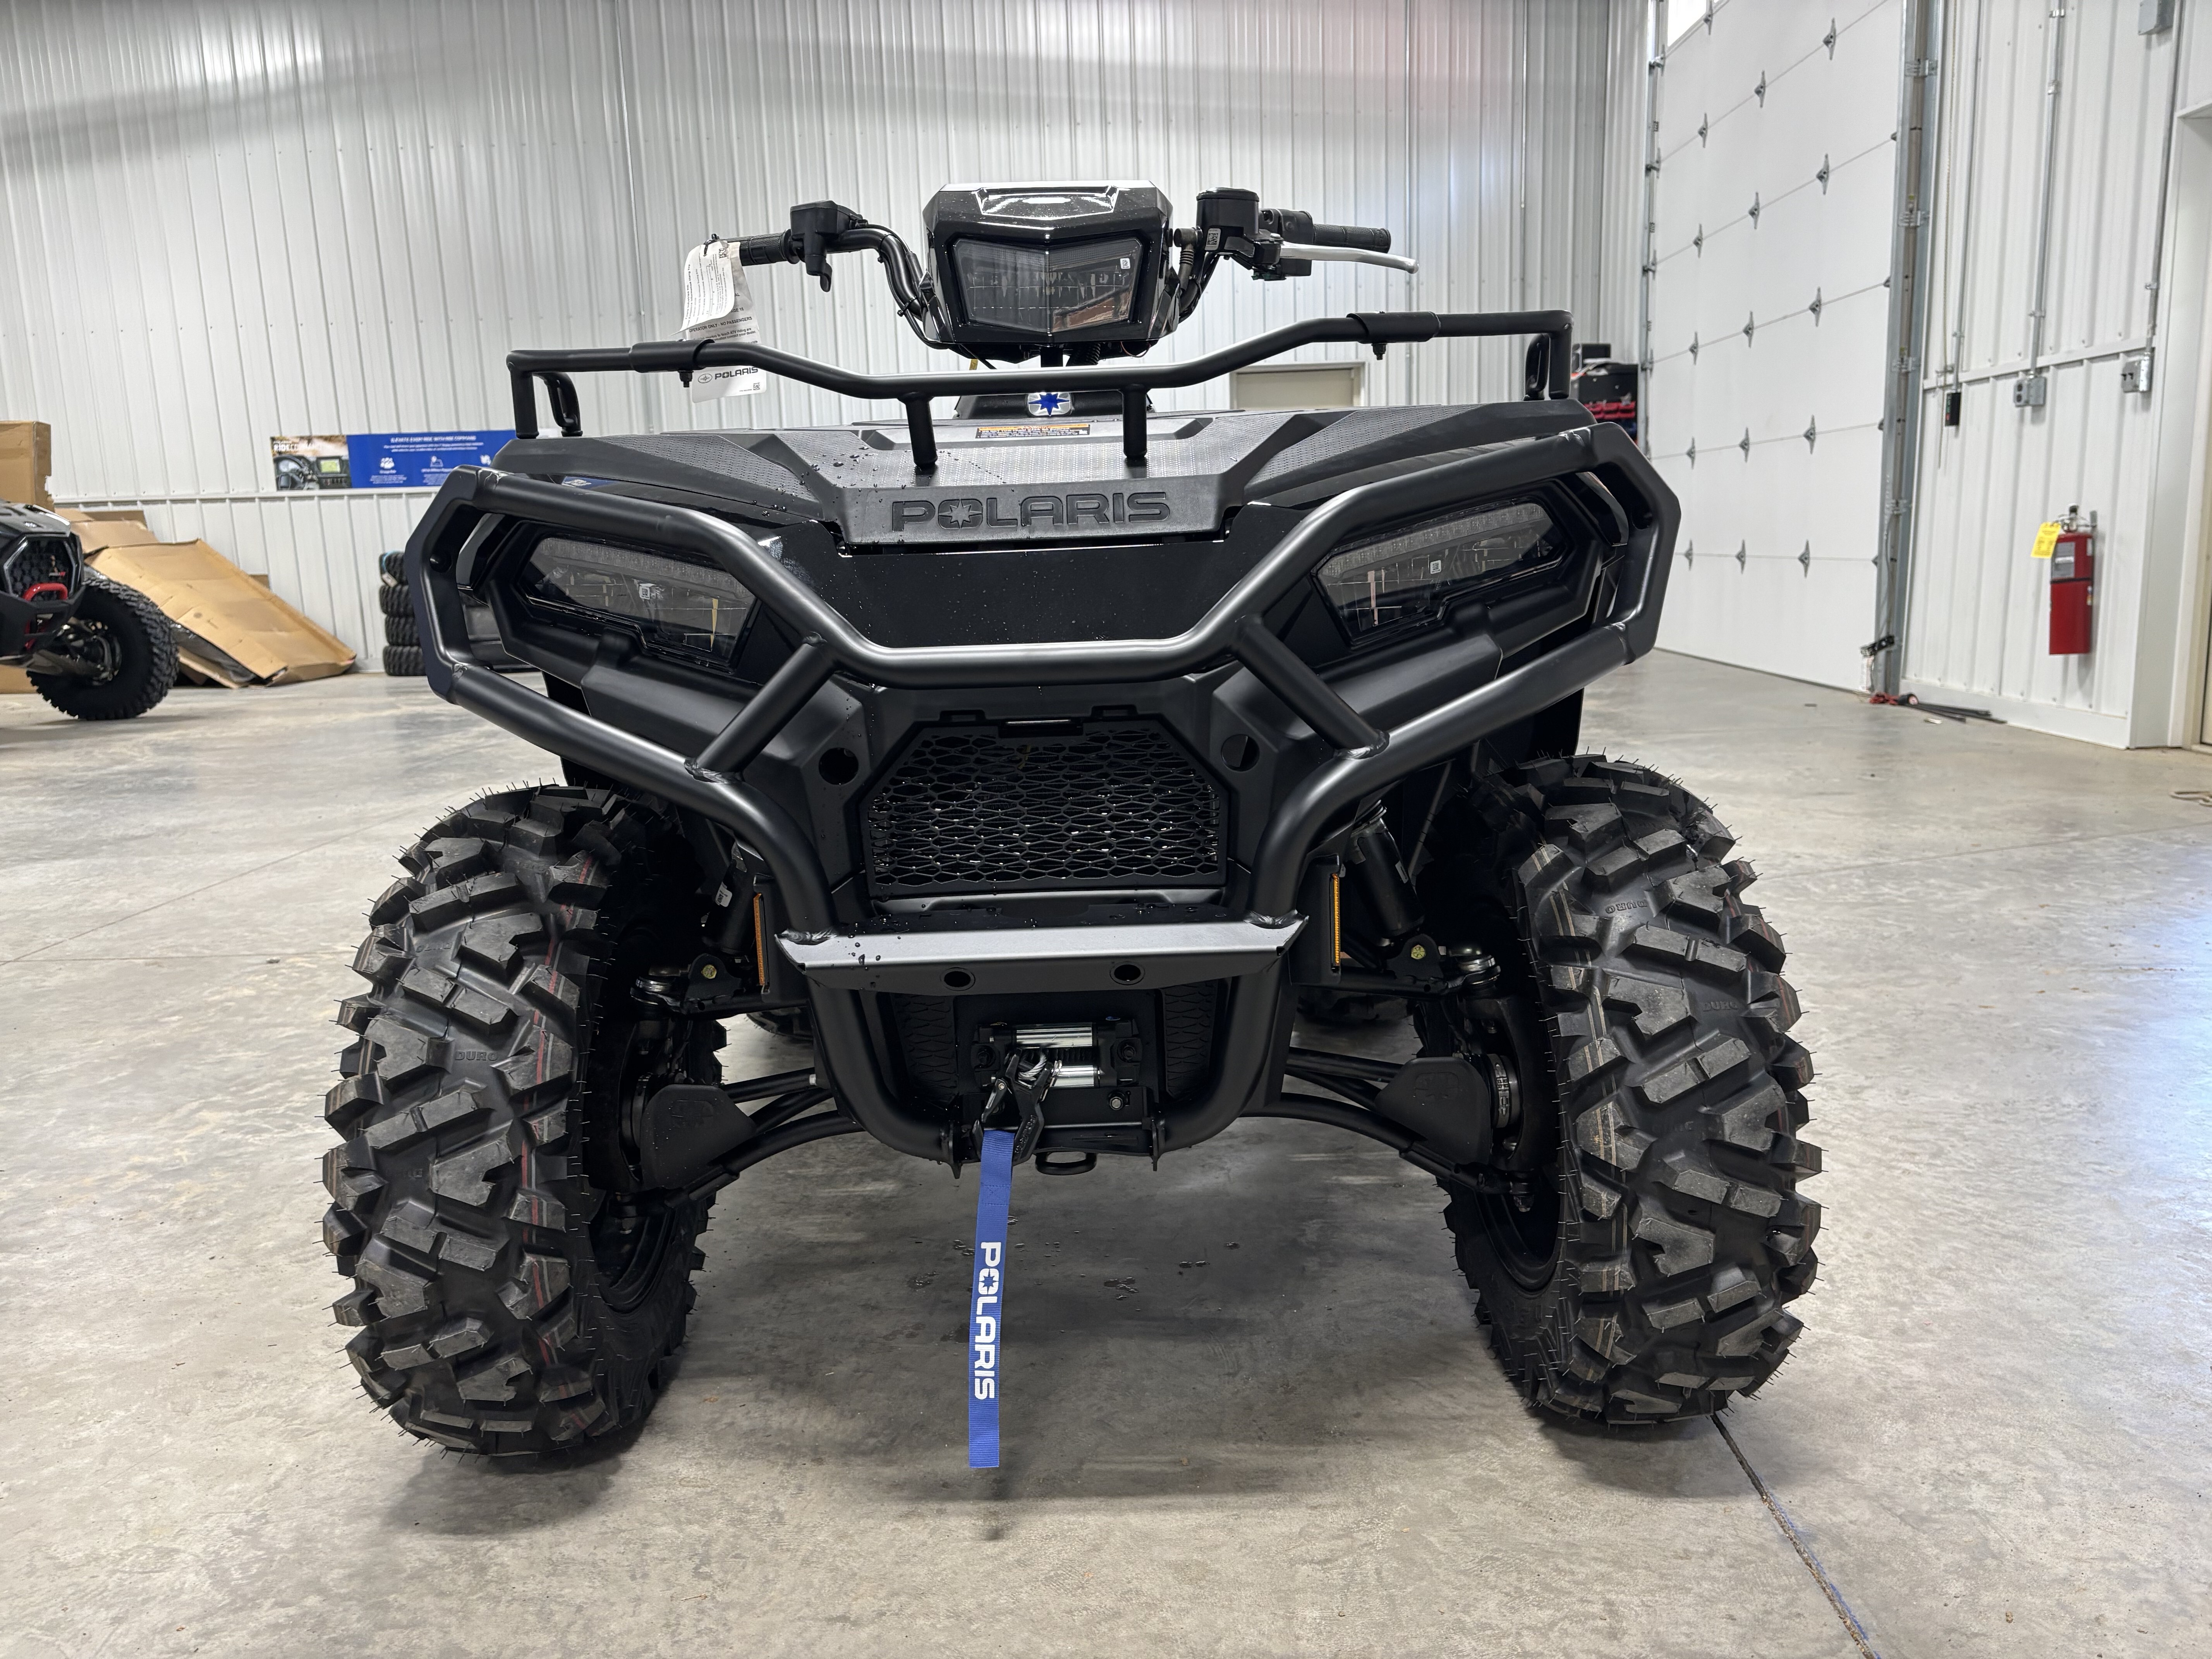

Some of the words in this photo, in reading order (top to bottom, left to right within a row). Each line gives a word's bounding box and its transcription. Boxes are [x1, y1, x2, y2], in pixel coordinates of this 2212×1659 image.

[726, 316, 752, 325] PASSENGERS
[715, 367, 758, 380] POLARIS
[892, 492, 1170, 531] POLARIS
[455, 1051, 498, 1061] DURO
[974, 1242, 1001, 1400] POLARIS
